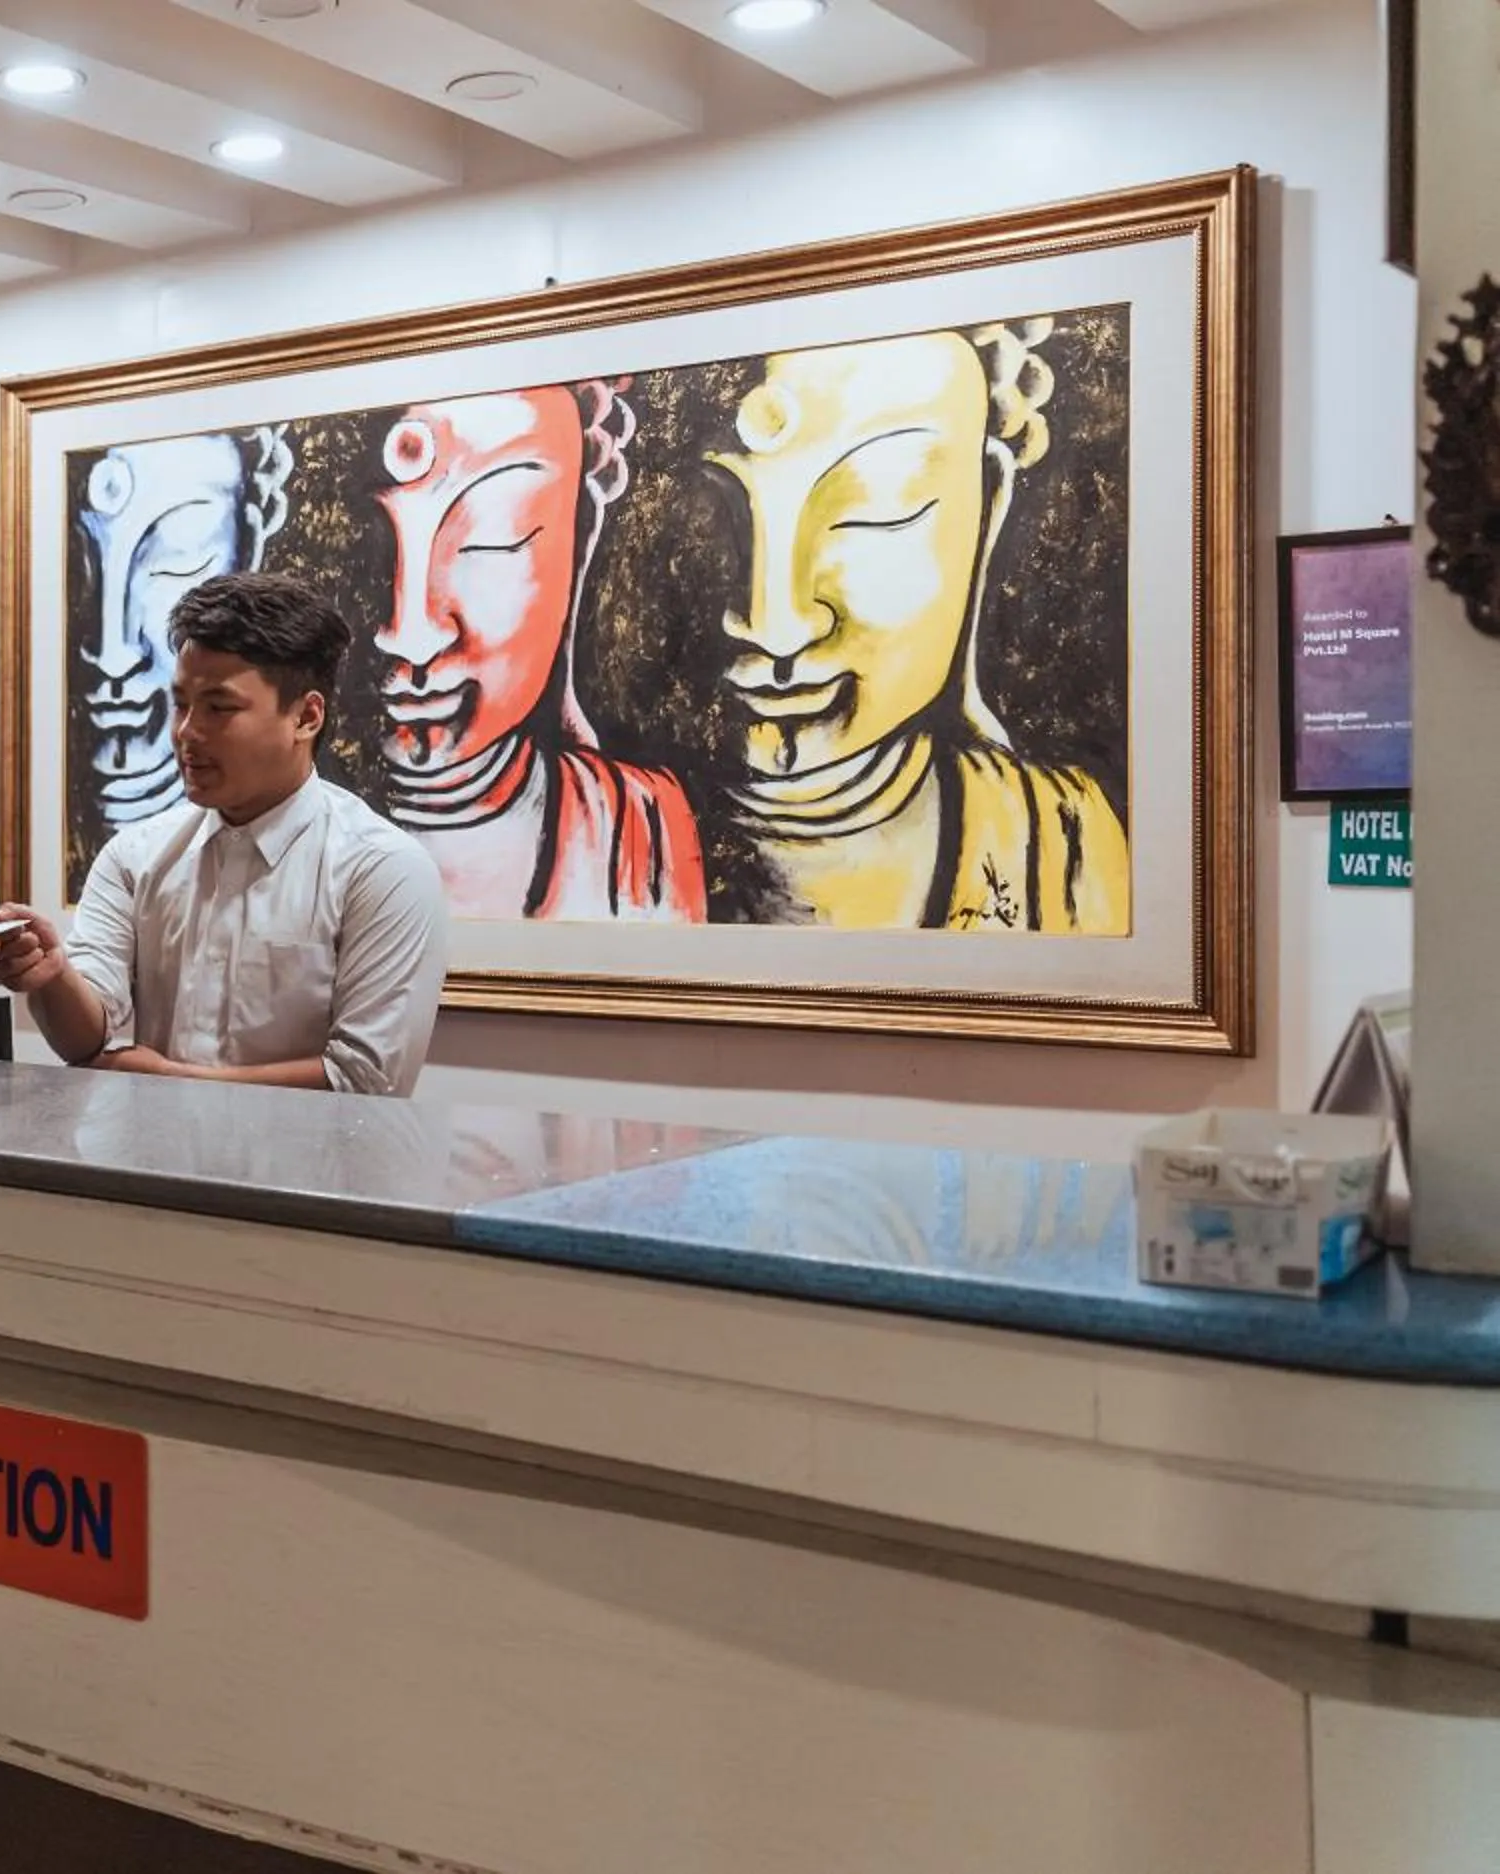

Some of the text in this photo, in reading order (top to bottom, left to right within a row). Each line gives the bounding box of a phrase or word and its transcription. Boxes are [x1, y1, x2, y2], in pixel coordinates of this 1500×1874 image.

[1303, 609, 1368, 621] Awarded to
[1303, 628, 1400, 641] Hotel M Square
[1303, 643, 1348, 656] Pvt.Ltd
[1341, 810, 1404, 840] HOTEL
[1339, 853, 1414, 877] VAT No
